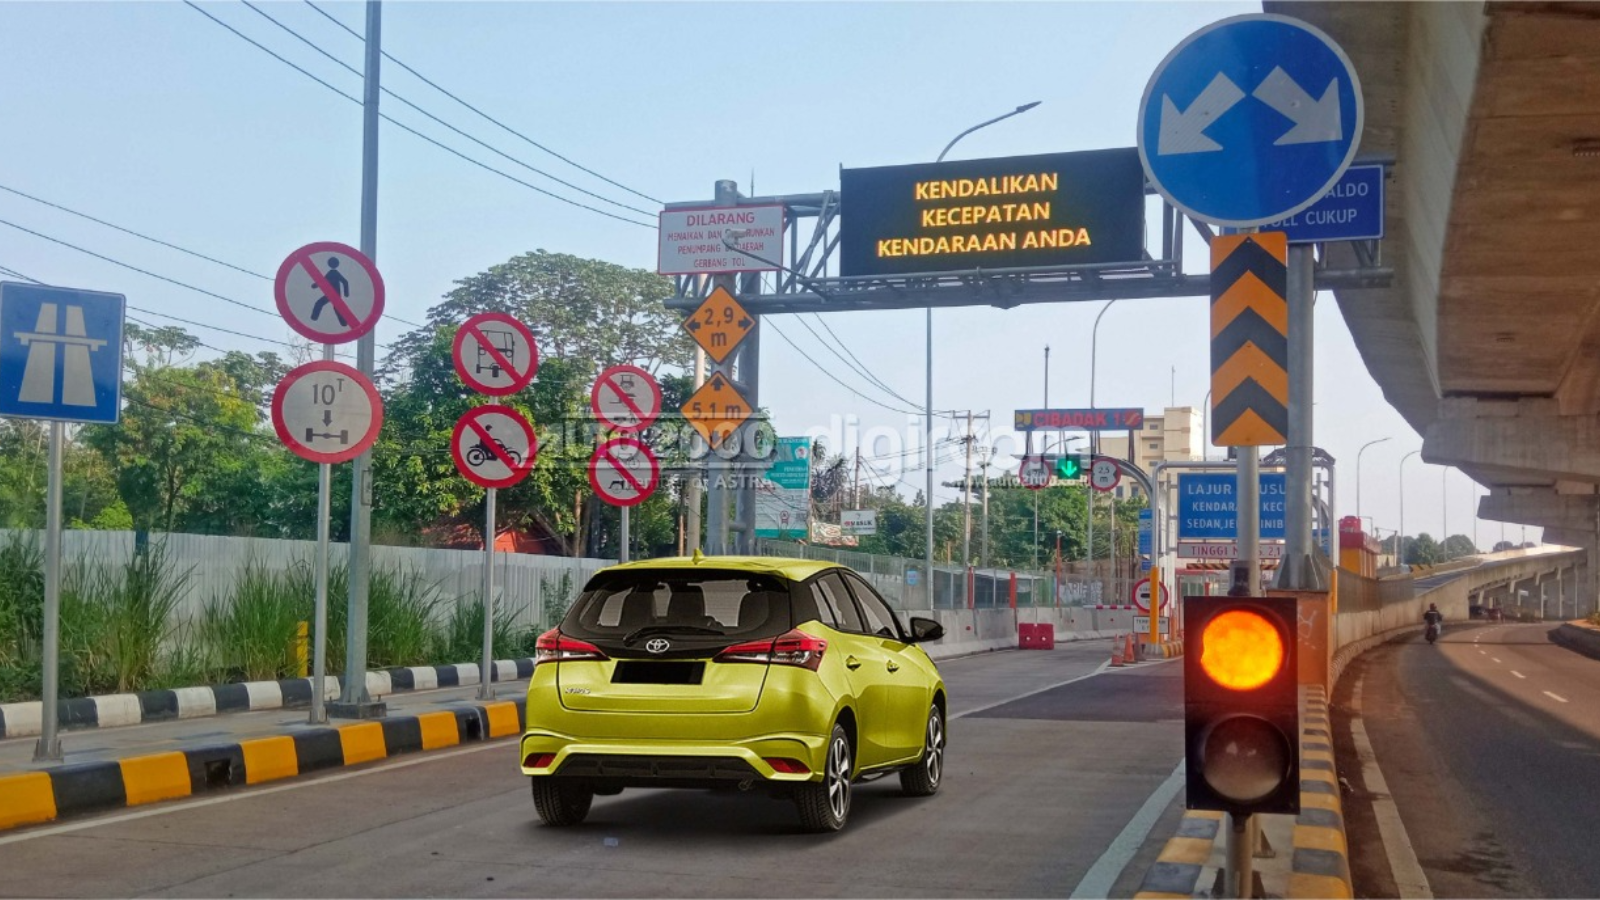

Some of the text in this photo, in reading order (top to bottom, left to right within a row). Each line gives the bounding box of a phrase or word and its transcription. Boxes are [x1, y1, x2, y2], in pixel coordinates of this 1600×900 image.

[915, 172, 1058, 200] KENDALIKAN
[1325, 182, 1369, 198] ALDO
[686, 212, 755, 226] DILARANG
[921, 201, 1051, 227] KECEPATAN
[1305, 208, 1357, 225] CUKUP
[668, 231, 704, 241] MENAIKAN
[708, 230, 722, 239] DAN
[877, 227, 1092, 257] KENDARAAN ANDA
[677, 244, 721, 254] PENUMPANG
[693, 257, 745, 268] GERBANG TOL
[704, 307, 733, 327] 2,9
[711, 332, 727, 347] m
[692, 402, 741, 421] 5,1 m
[1033, 411, 1120, 427] CIBADAK 1
[1188, 484, 1232, 495] LAJUR
[1191, 545, 1228, 556] TINGGI
